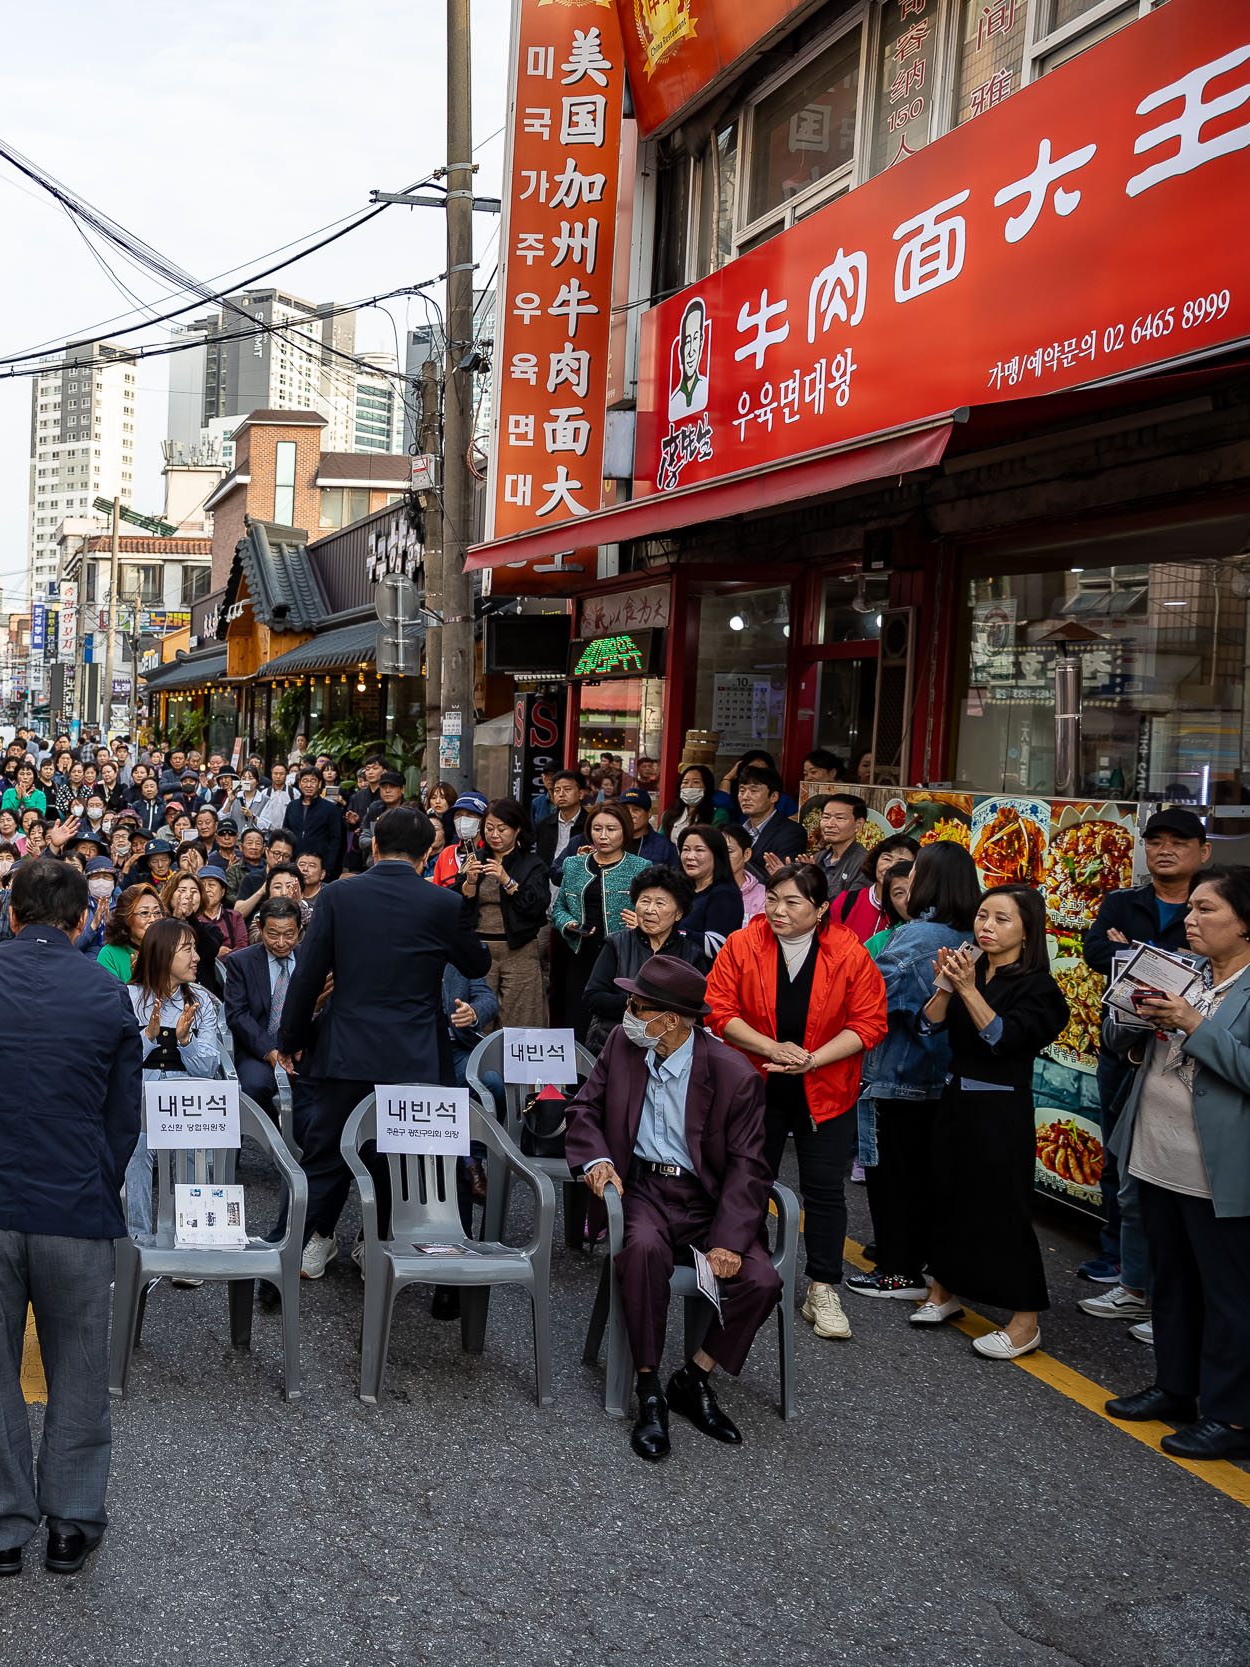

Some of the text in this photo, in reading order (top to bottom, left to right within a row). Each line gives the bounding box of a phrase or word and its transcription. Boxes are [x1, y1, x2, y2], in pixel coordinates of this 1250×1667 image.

[650, 17, 687, 57] China Restaurant
[504, 47, 554, 567] 미국가주우육면대
[533, 27, 612, 572] 美国加州牛肉面大
[987, 289, 1231, 391] 가맹/예약문의 02 6465 8999
[732, 347, 858, 443] 우육면대왕
[514, 701, 525, 748] S
[1061, 899, 1085, 913] 소고기
[511, 1042, 566, 1063] 내빈석
[158, 1095, 227, 1117] 내빈석
[388, 1099, 456, 1123] 내빈석
[160, 1123, 227, 1132] 오신환 당협위원장
[408, 1128, 442, 1138] 광진구의회
[444, 1130, 459, 1139] 의장
